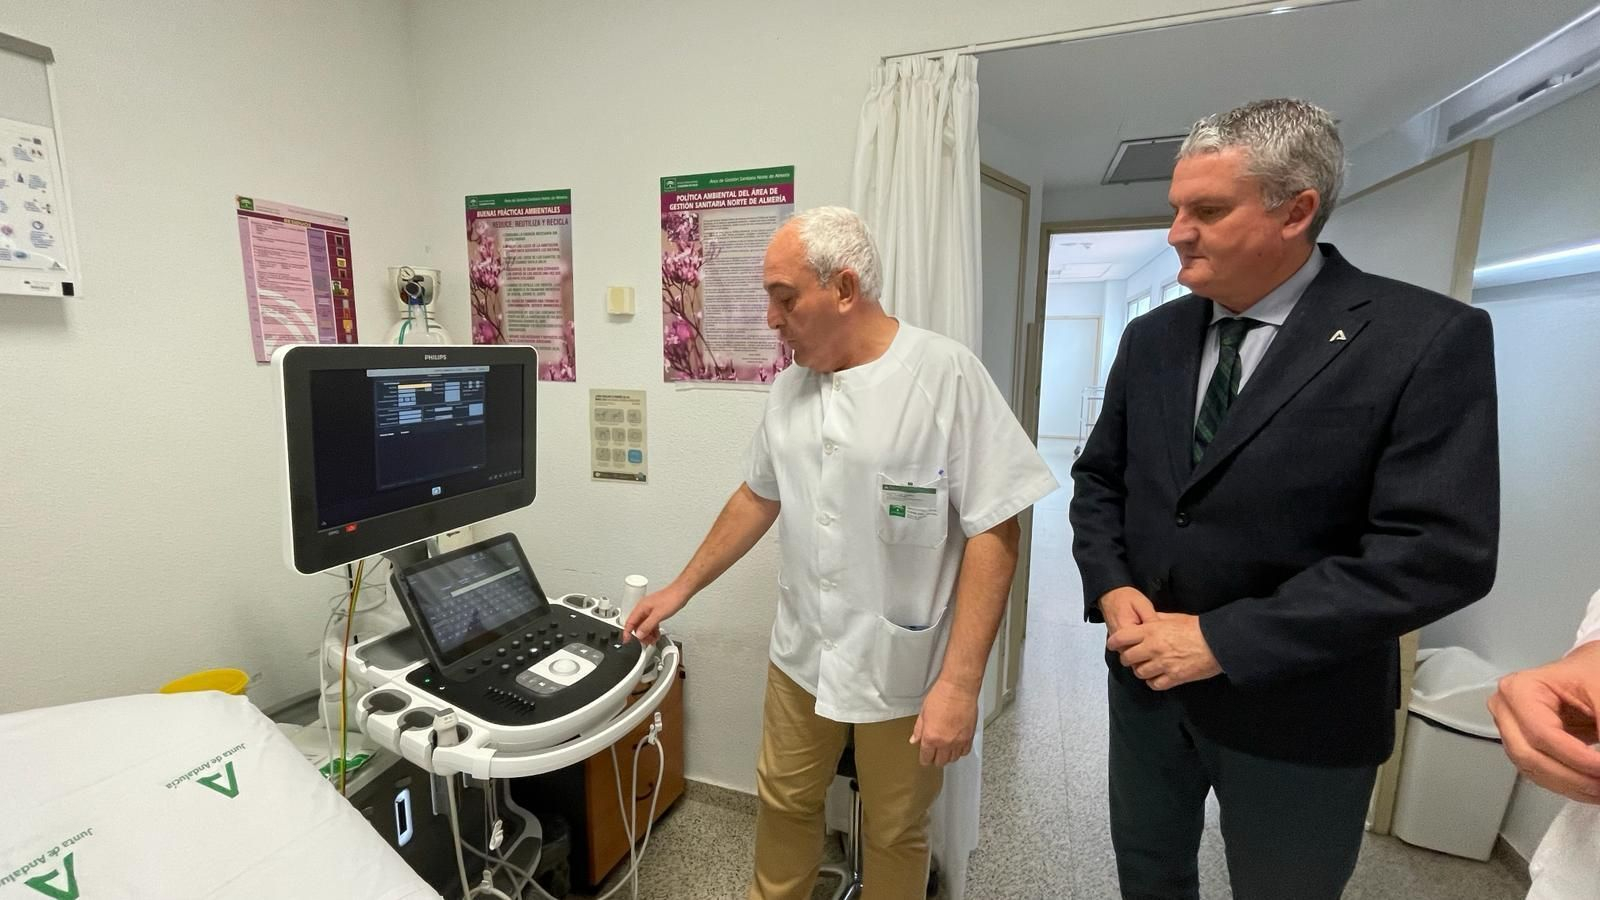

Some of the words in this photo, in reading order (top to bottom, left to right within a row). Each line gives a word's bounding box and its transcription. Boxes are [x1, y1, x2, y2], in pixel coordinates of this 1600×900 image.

[676, 193, 702, 202] POLÍTICA
[703, 191, 736, 200] AMBIENTAL
[751, 188, 768, 196] ÁREA
[669, 202, 694, 211] GESTIÓN
[695, 200, 726, 209] SANITARIA
[727, 198, 747, 206] NORTE
[758, 196, 786, 204] ALMERÍA
[477, 210, 497, 218] BUENAS
[497, 208, 524, 217] PRÁCTICAS
[524, 206, 561, 215] AMBIENTALES
[515, 220, 541, 228] REUTILIZA
[546, 218, 569, 226] RECICLA
[222, 743, 246, 757] Junta
[210, 755, 223, 764] de
[166, 762, 211, 789] Andalucía
[62, 828, 93, 848] Junta
[47, 846, 60, 857] de
